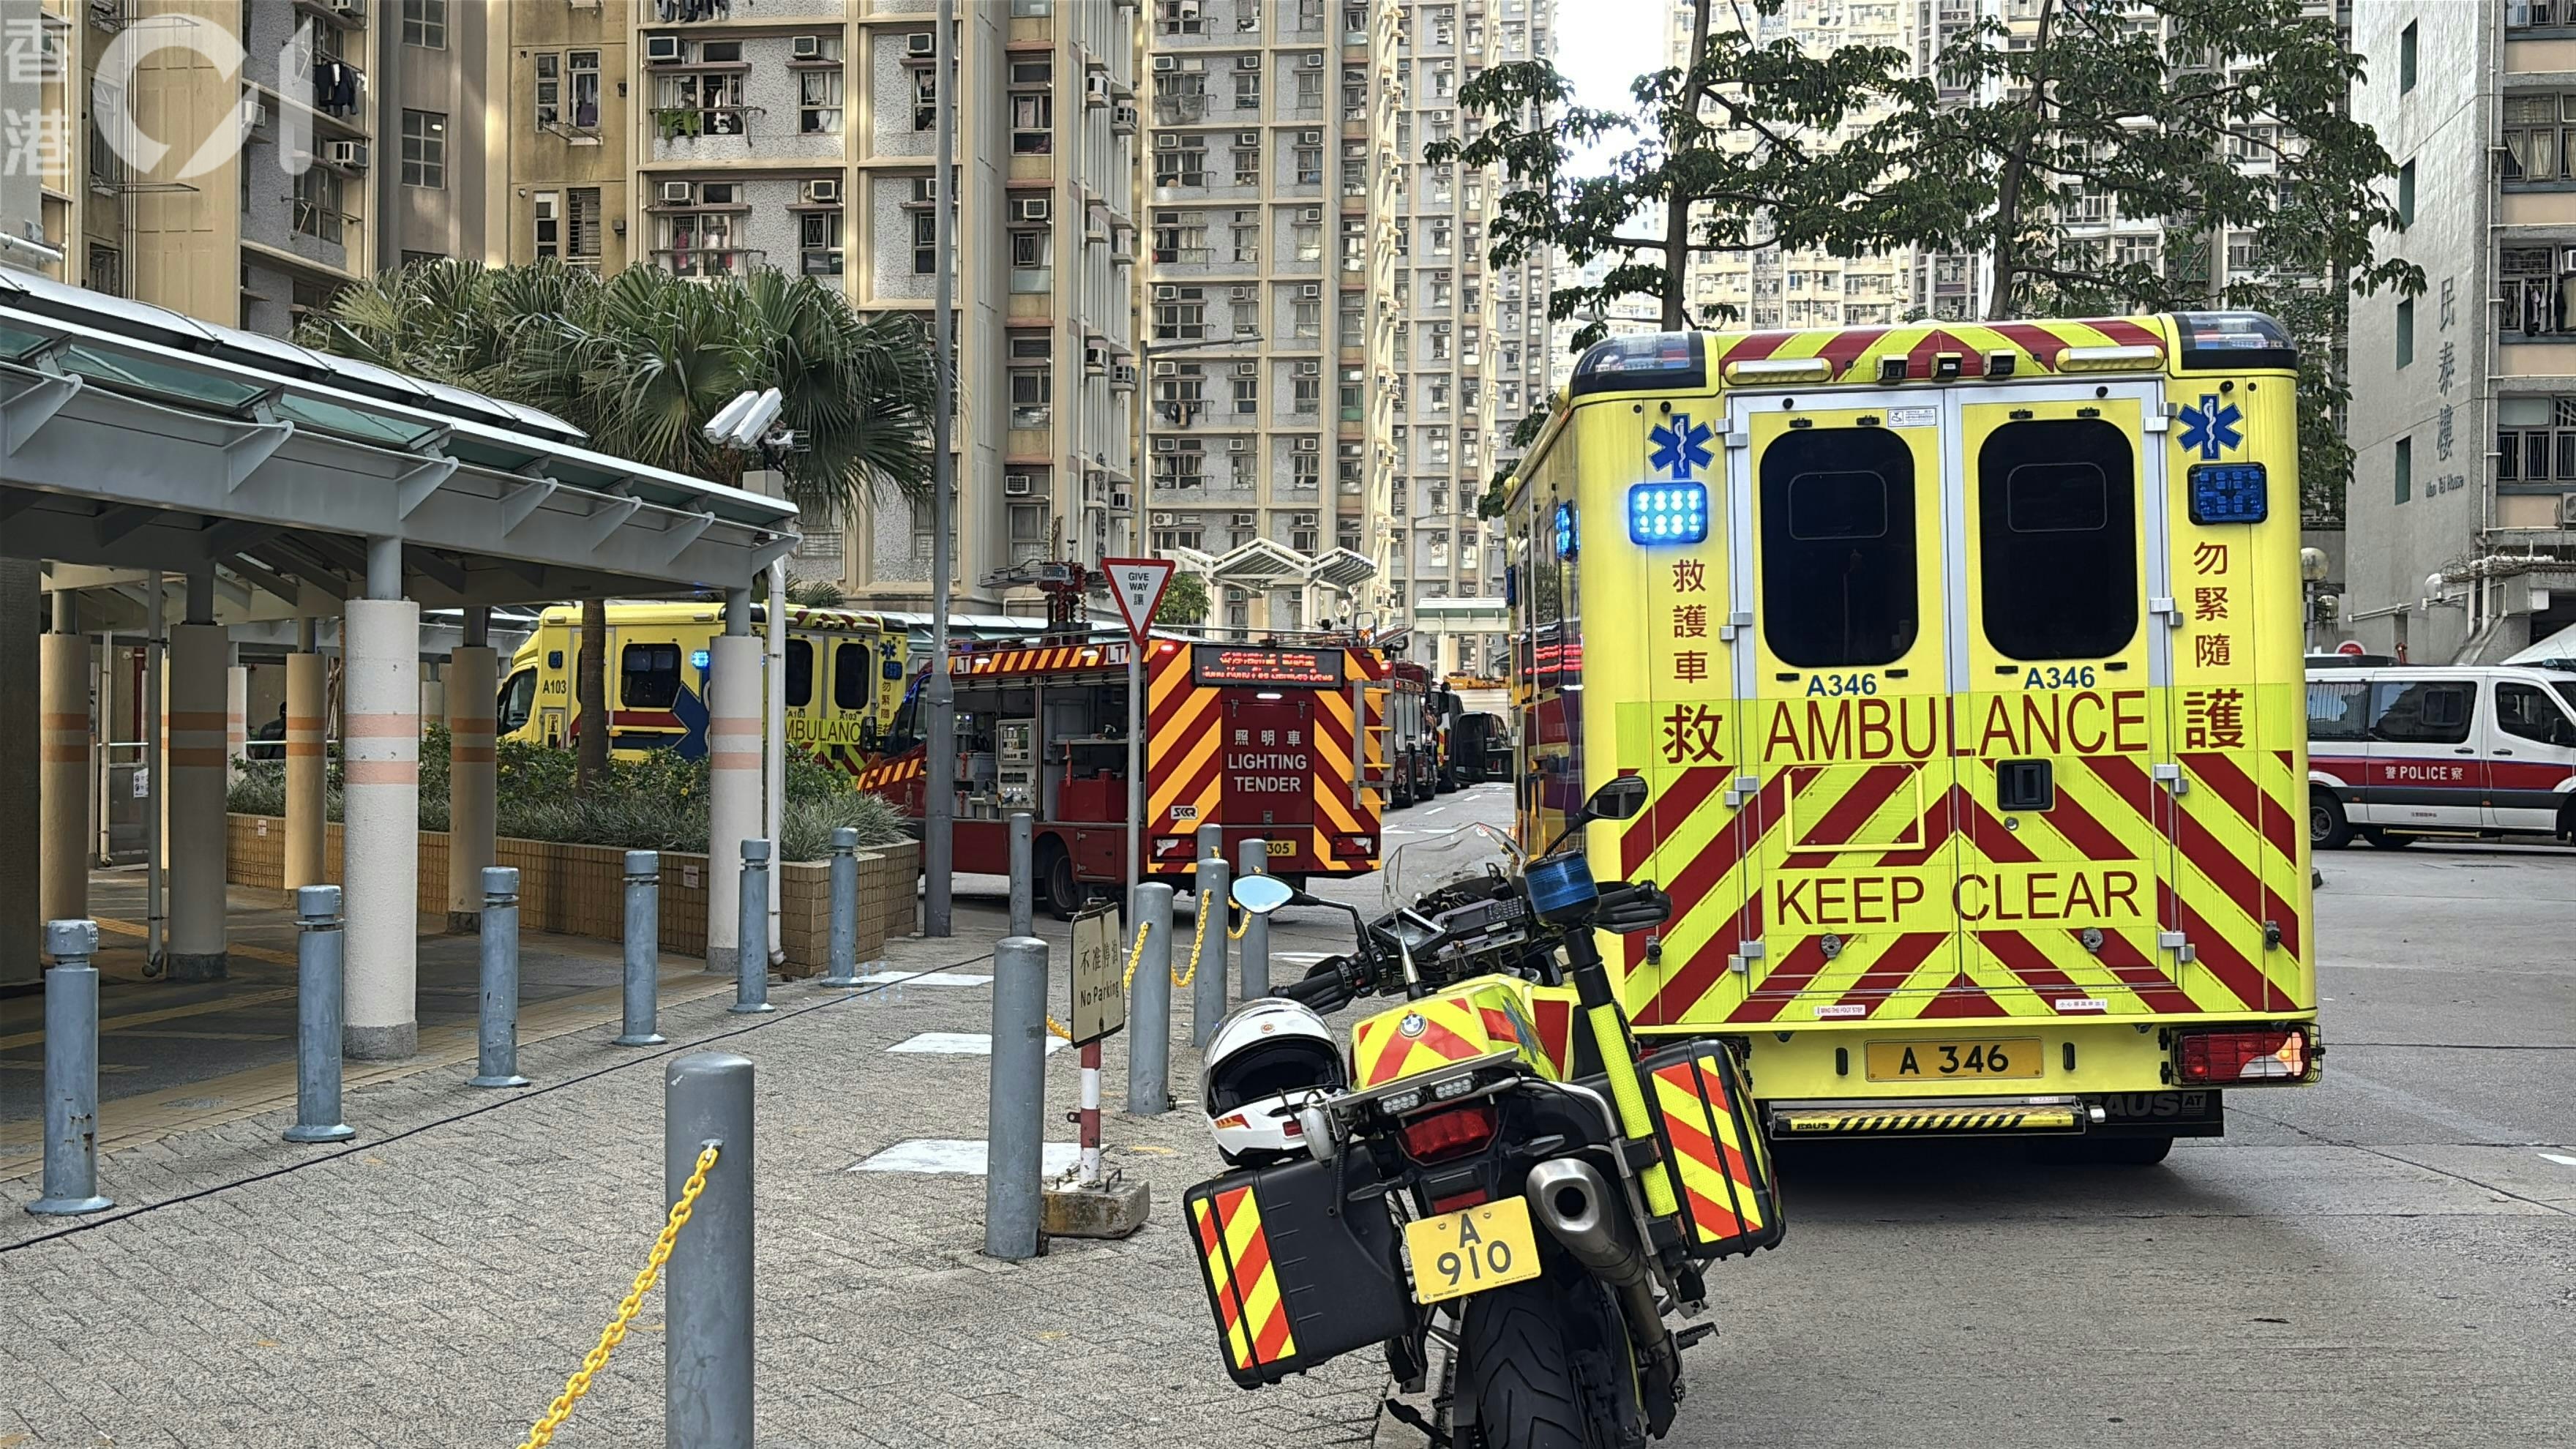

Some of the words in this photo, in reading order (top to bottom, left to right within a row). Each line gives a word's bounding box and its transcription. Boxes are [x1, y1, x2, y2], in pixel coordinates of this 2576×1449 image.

[2436, 275, 2455, 461] 民泰樓
[1128, 572, 1150, 581] GIVE
[1129, 583, 1148, 591] WAY
[1134, 594, 1144, 606] 讓
[2193, 541, 2231, 669] 勿緊隨
[1671, 558, 1708, 684] 救護車
[1107, 645, 1125, 662] LT
[955, 657, 969, 673] LT
[542, 679, 567, 694] A103
[1805, 673, 1877, 697] A346
[2024, 665, 2095, 689] A346
[787, 710, 806, 718] A103
[785, 719, 861, 742] MBULANC
[1662, 703, 1724, 764] 救
[1764, 690, 2148, 762] AMBULANCE
[2184, 687, 2246, 749] 護
[1234, 730, 1302, 747] 照明車
[1228, 753, 1307, 771] LIGHTING
[2385, 765, 2397, 779] 警
[2400, 765, 2447, 780] POLICE
[2451, 767, 2463, 780] 察
[1234, 776, 1301, 792] TENDER
[1267, 843, 1289, 854] 305
[1777, 875, 1924, 925] KEEP
[1952, 871, 2141, 921] CLEAR
[1080, 940, 1118, 976] 不准停泊
[1080, 989, 1092, 1008] No
[1093, 979, 1120, 1002] Parking
[1899, 1046, 1920, 1075] A
[1938, 1044, 2009, 1074] 346
[2187, 1094, 2203, 1107] AT
[1459, 1213, 1482, 1248] A
[1437, 1240, 1511, 1287] 910
